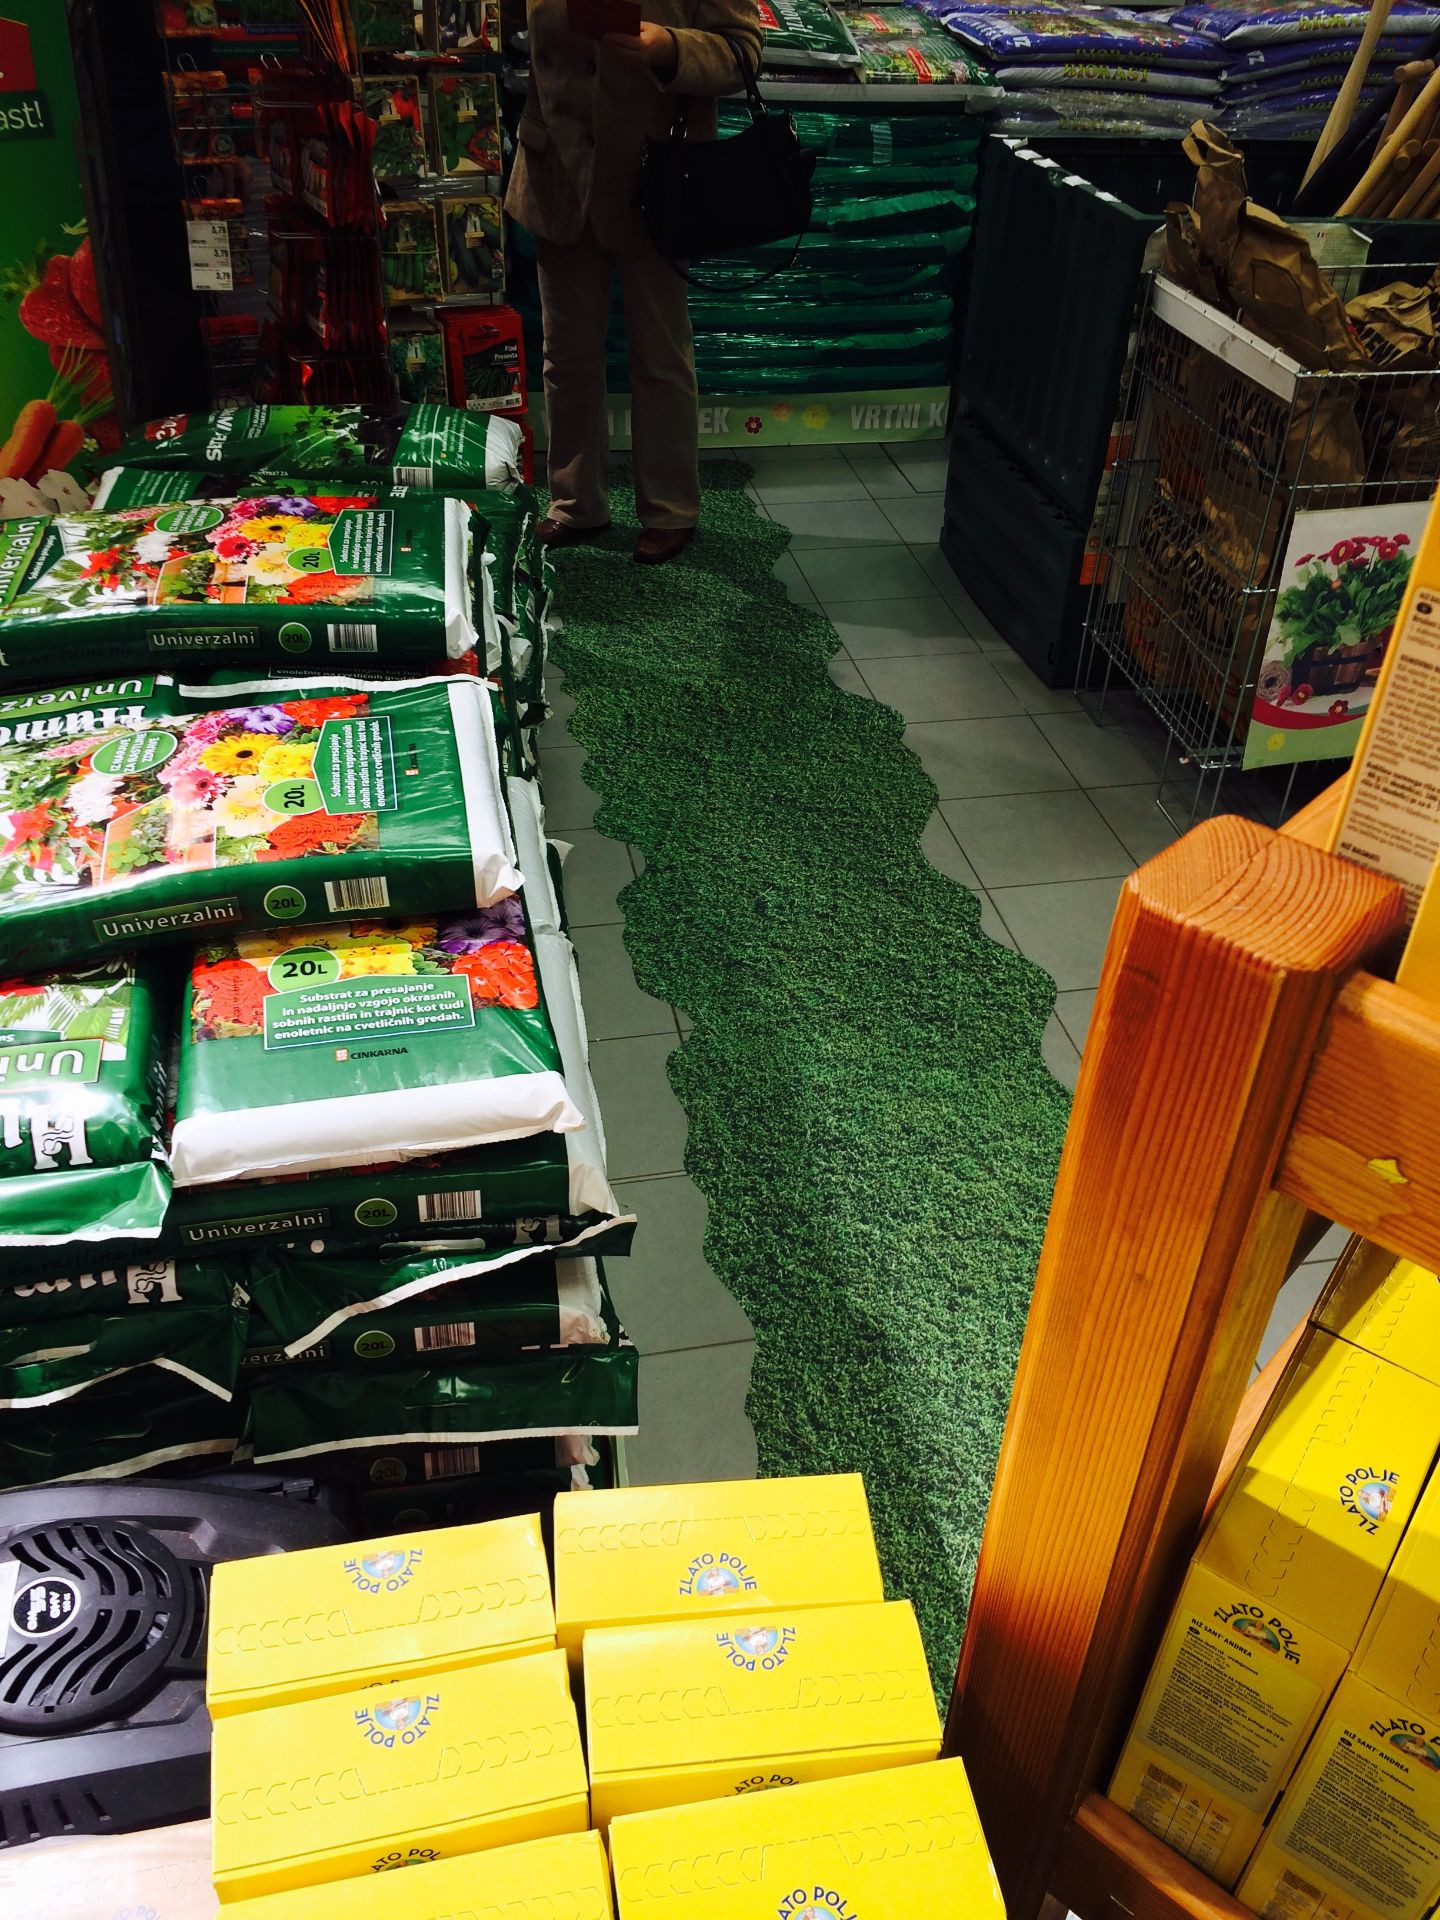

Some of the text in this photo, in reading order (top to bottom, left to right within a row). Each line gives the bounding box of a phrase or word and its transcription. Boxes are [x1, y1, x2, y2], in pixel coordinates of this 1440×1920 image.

[850, 402, 947, 430] VRTNI K
[302, 550, 320, 571] 20L
[152, 630, 255, 647] Univerzalni
[284, 633, 307, 643] 20L
[343, 725, 354, 748] okrasnih
[356, 720, 365, 731] tudi
[357, 732, 366, 742] kot
[370, 720, 383, 741] gredah.
[344, 748, 357, 768] vzgojo
[358, 742, 369, 761] trajnic
[372, 741, 384, 769] cvetličnih
[329, 733, 342, 798] Substrat za presajanje
[344, 769, 357, 797] nadaljnjo
[359, 768, 370, 787] rastlin
[285, 785, 306, 808] 20L
[360, 788, 371, 808] sobnih
[374, 778, 386, 806] enoletnic
[272, 897, 299, 910] 20L
[102, 902, 235, 939] Univerzalni
[282, 960, 328, 978] 20L
[282, 990, 456, 1016] in nadaljnjo vzgojo okrasnih
[299, 982, 434, 1003] Substrat za presajanje
[272, 1000, 464, 1029] sobnih rastlin in trajnic kot tudi
[274, 1012, 464, 1040] enoletnic na cvetličnih gredah.
[350, 1047, 408, 1060] CINKARNA
[362, 1209, 391, 1220] 20L
[189, 1211, 325, 1242] Univerzalni
[361, 1341, 389, 1351] 20L
[1339, 1465, 1400, 1537] ZLATO POLJE
[344, 1548, 422, 1594] ZLATO POLJE
[679, 1552, 757, 1596] ZLATO POLJE
[1212, 1602, 1301, 1665] ZLATO POLJE
[716, 1626, 796, 1672] ZLATO POLJE
[1223, 1637, 1253, 1658] ANDREA
[354, 1694, 441, 1748] ZLATO POLJE
[1368, 1716, 1425, 1739] ZLATO
[1379, 1750, 1409, 1774] ANDREA
[734, 1775, 764, 1794] ATO
[370, 1848, 441, 1873] ATO POL
[777, 1888, 807, 1920] ATO
